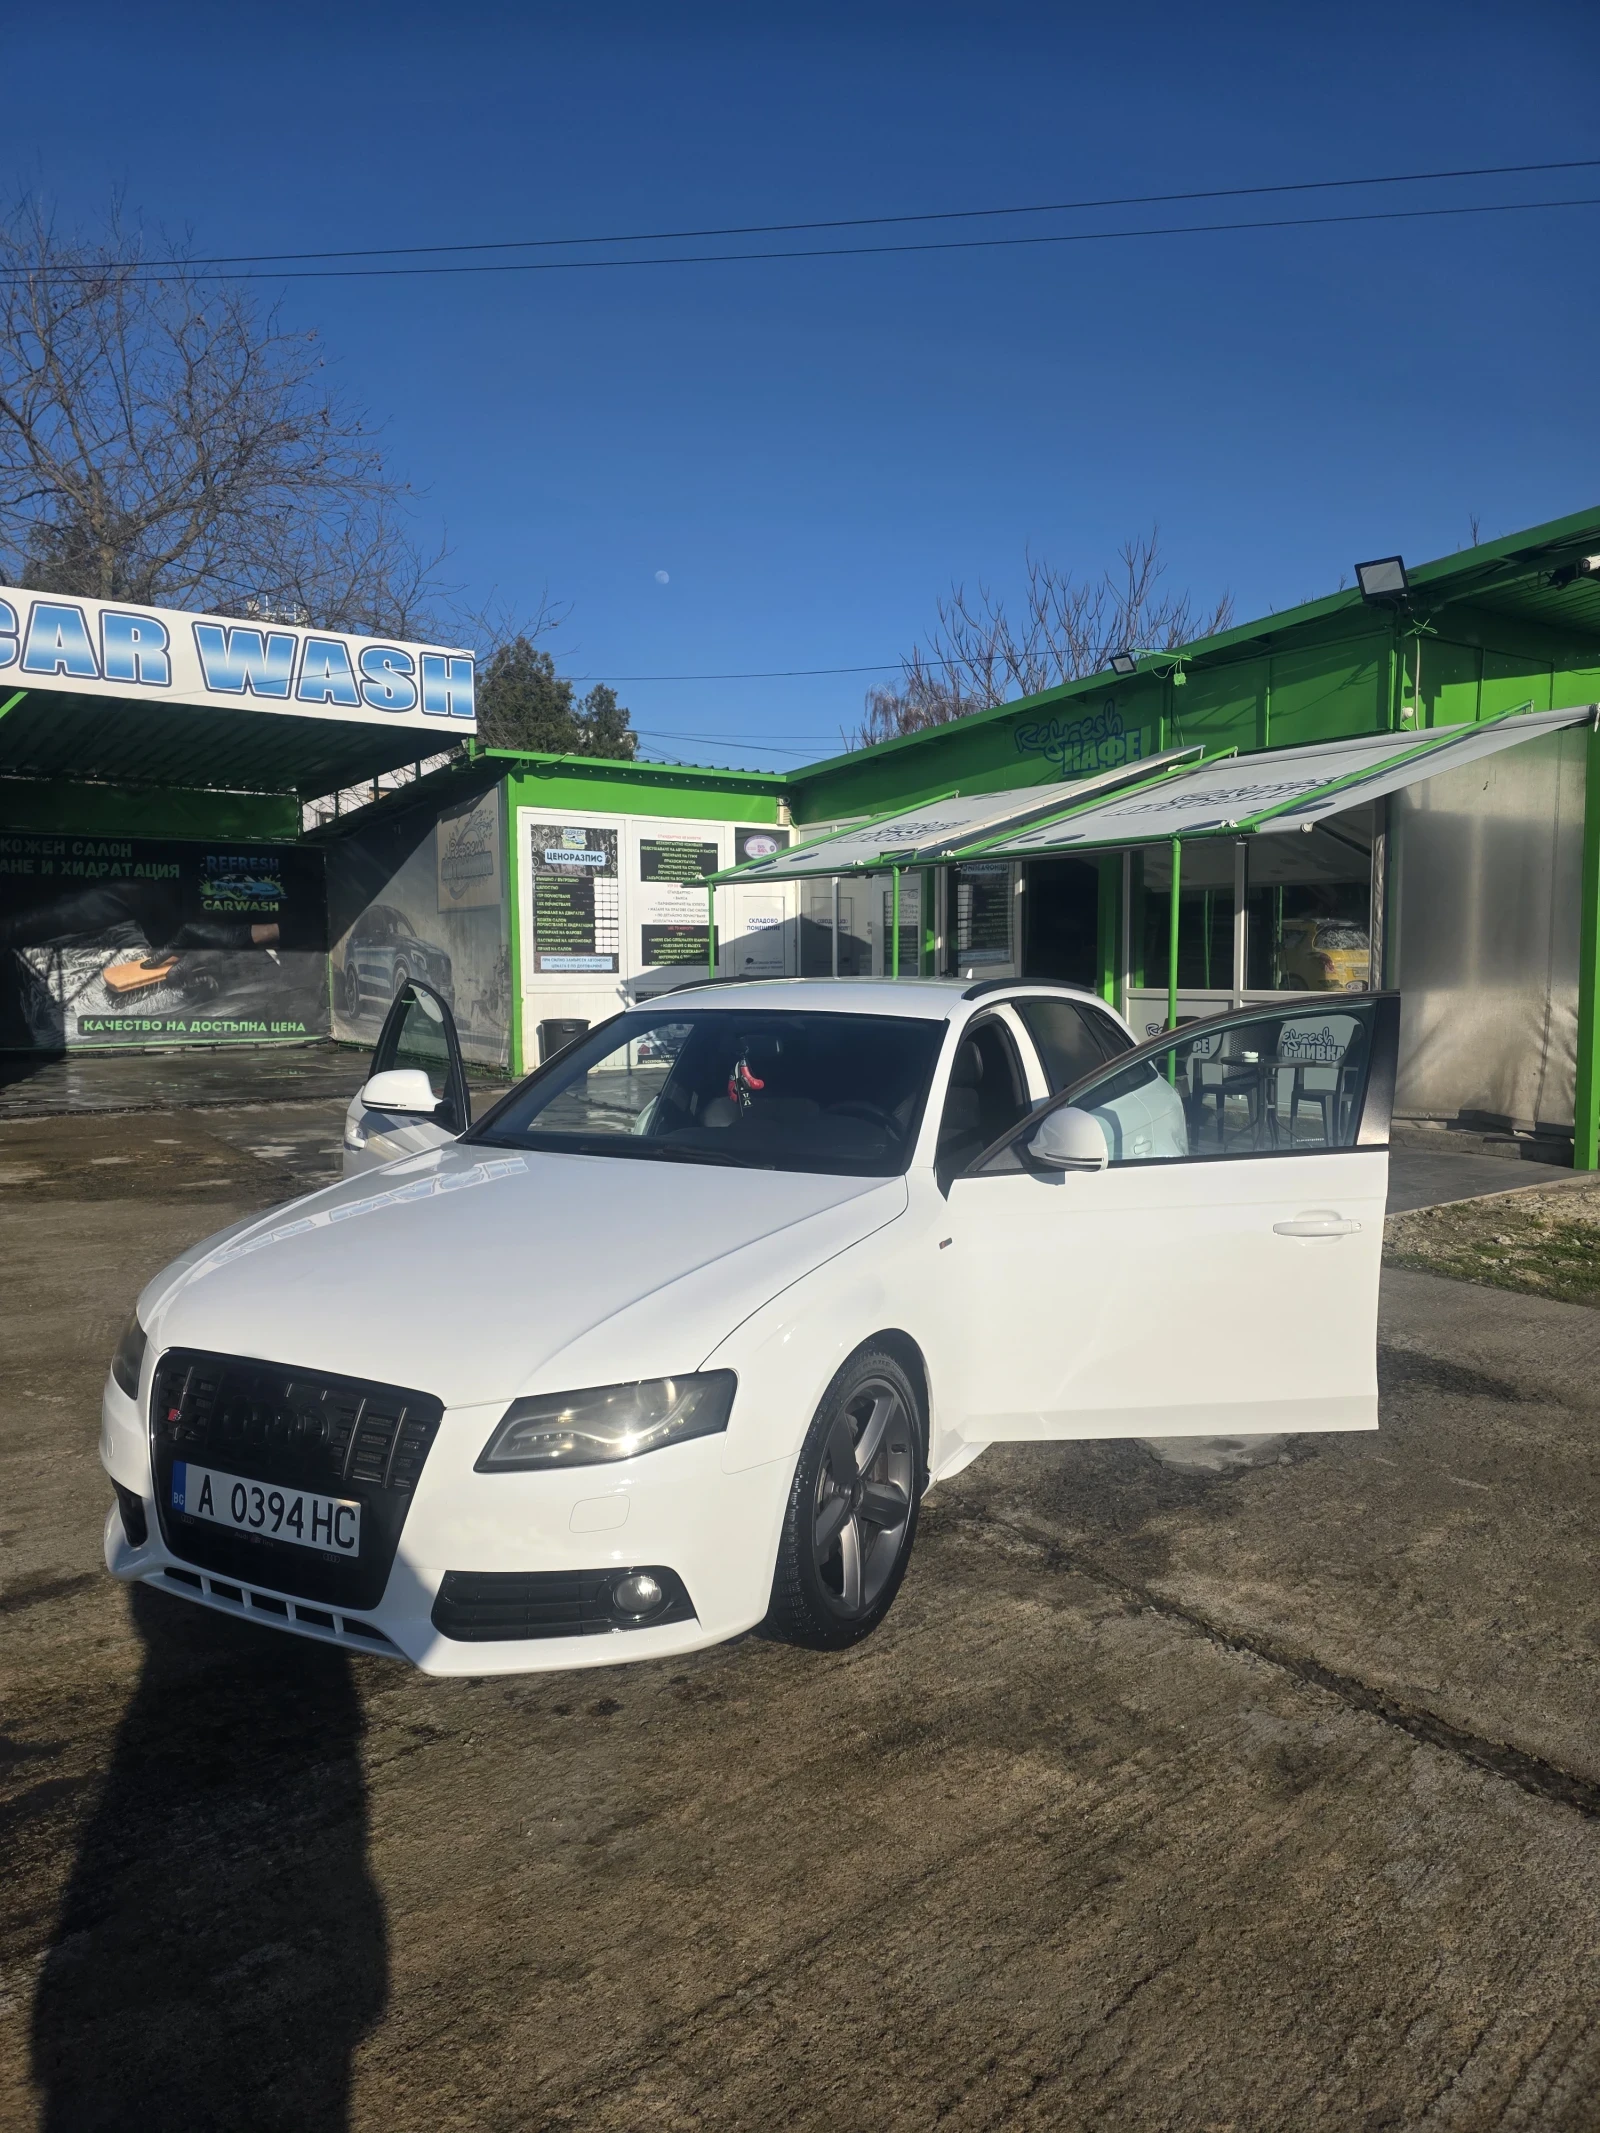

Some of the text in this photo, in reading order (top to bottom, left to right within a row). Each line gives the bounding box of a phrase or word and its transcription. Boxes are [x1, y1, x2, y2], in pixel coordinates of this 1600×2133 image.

[0, 597, 476, 720] AR WASH
[1014, 698, 1124, 763] Refresh
[72, 842, 132, 858] САЛОН
[546, 852, 603, 863] ЦЕНОРАЗПИС
[41, 860, 54, 875] И
[60, 861, 180, 880] ХИДРАТАЦИЯ
[206, 855, 279, 873] REFRESH
[202, 900, 279, 912] CARWASH
[83, 1020, 306, 1034] КАЧЕСТВО НА ДОСТЪПНА ЦЕНА
[1281, 1042, 1346, 1062] ОМИВКА
[173, 1492, 184, 1505] BG
[198, 1474, 215, 1517] A
[231, 1482, 304, 1539] 0394
